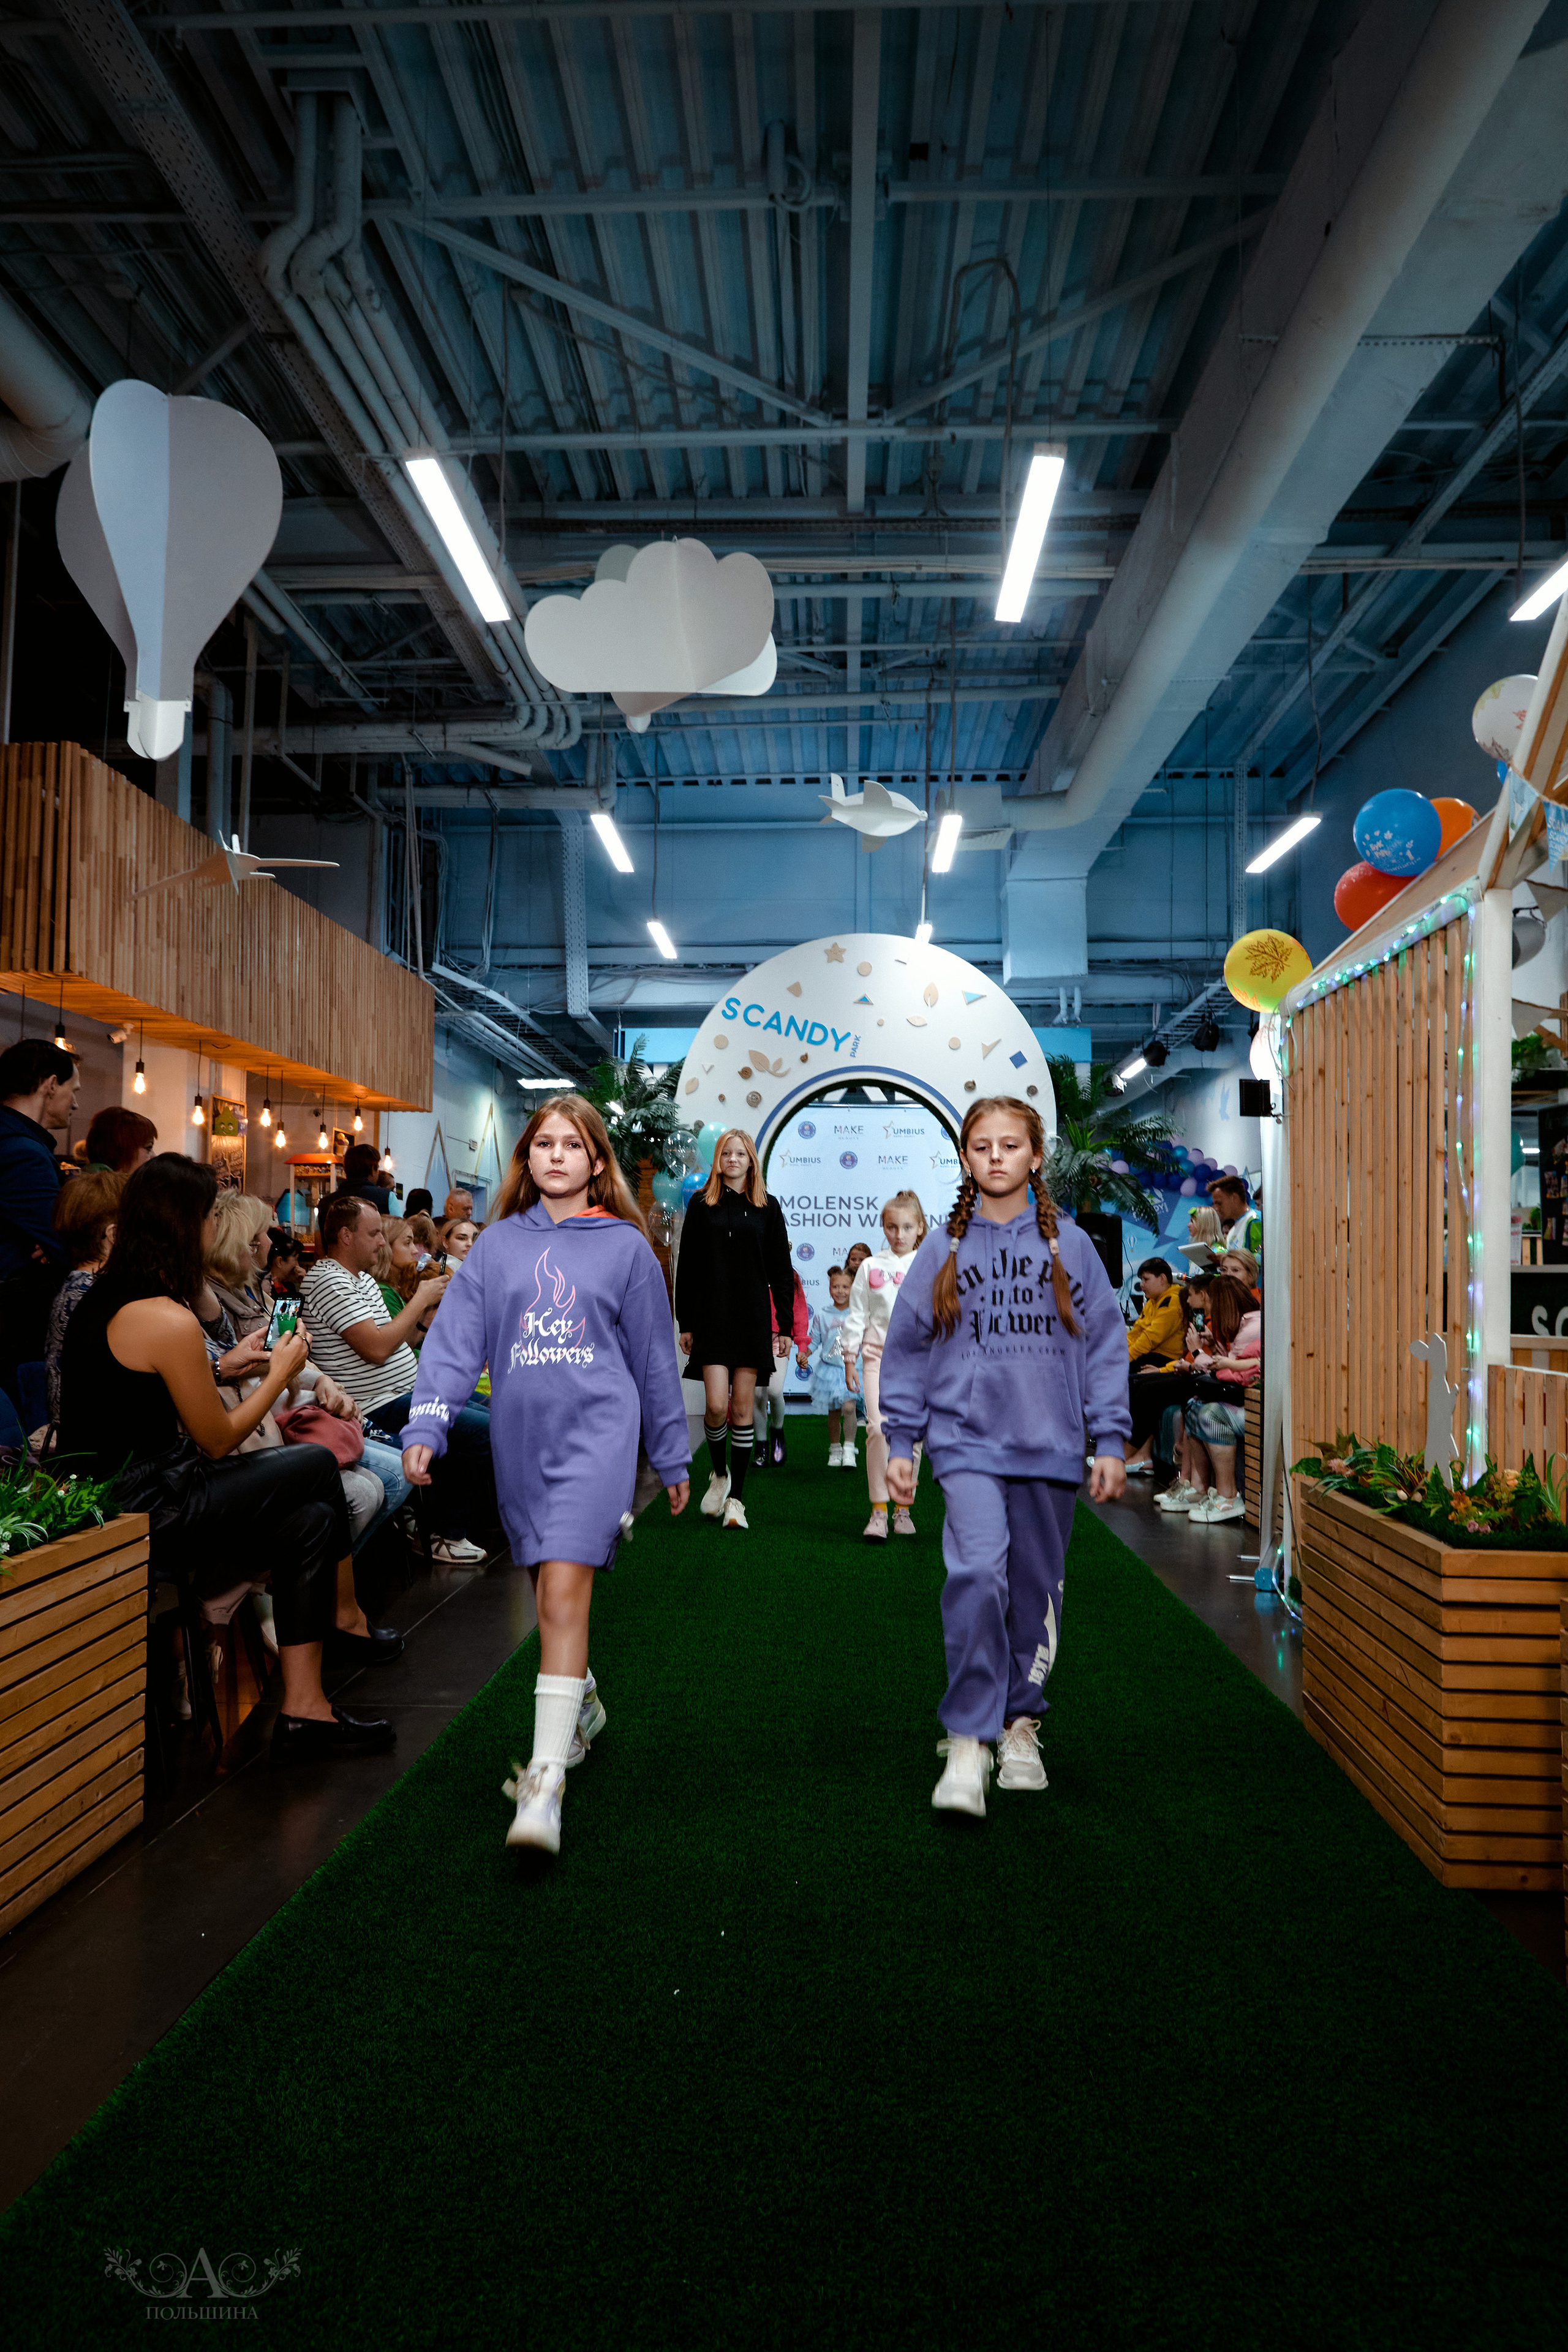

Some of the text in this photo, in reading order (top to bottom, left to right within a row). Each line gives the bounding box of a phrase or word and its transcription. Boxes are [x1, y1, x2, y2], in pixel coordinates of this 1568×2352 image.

[721, 997, 851, 1052] SCANDY
[850, 1035, 862, 1058] PARK
[834, 1125, 864, 1134] MAKE
[878, 1155, 908, 1164] MAKE
[780, 1196, 878, 1210] MOLENSK
[833, 1248, 848, 1256] MA
[522, 1307, 573, 1344] Hey
[507, 1337, 595, 1374] Followers
